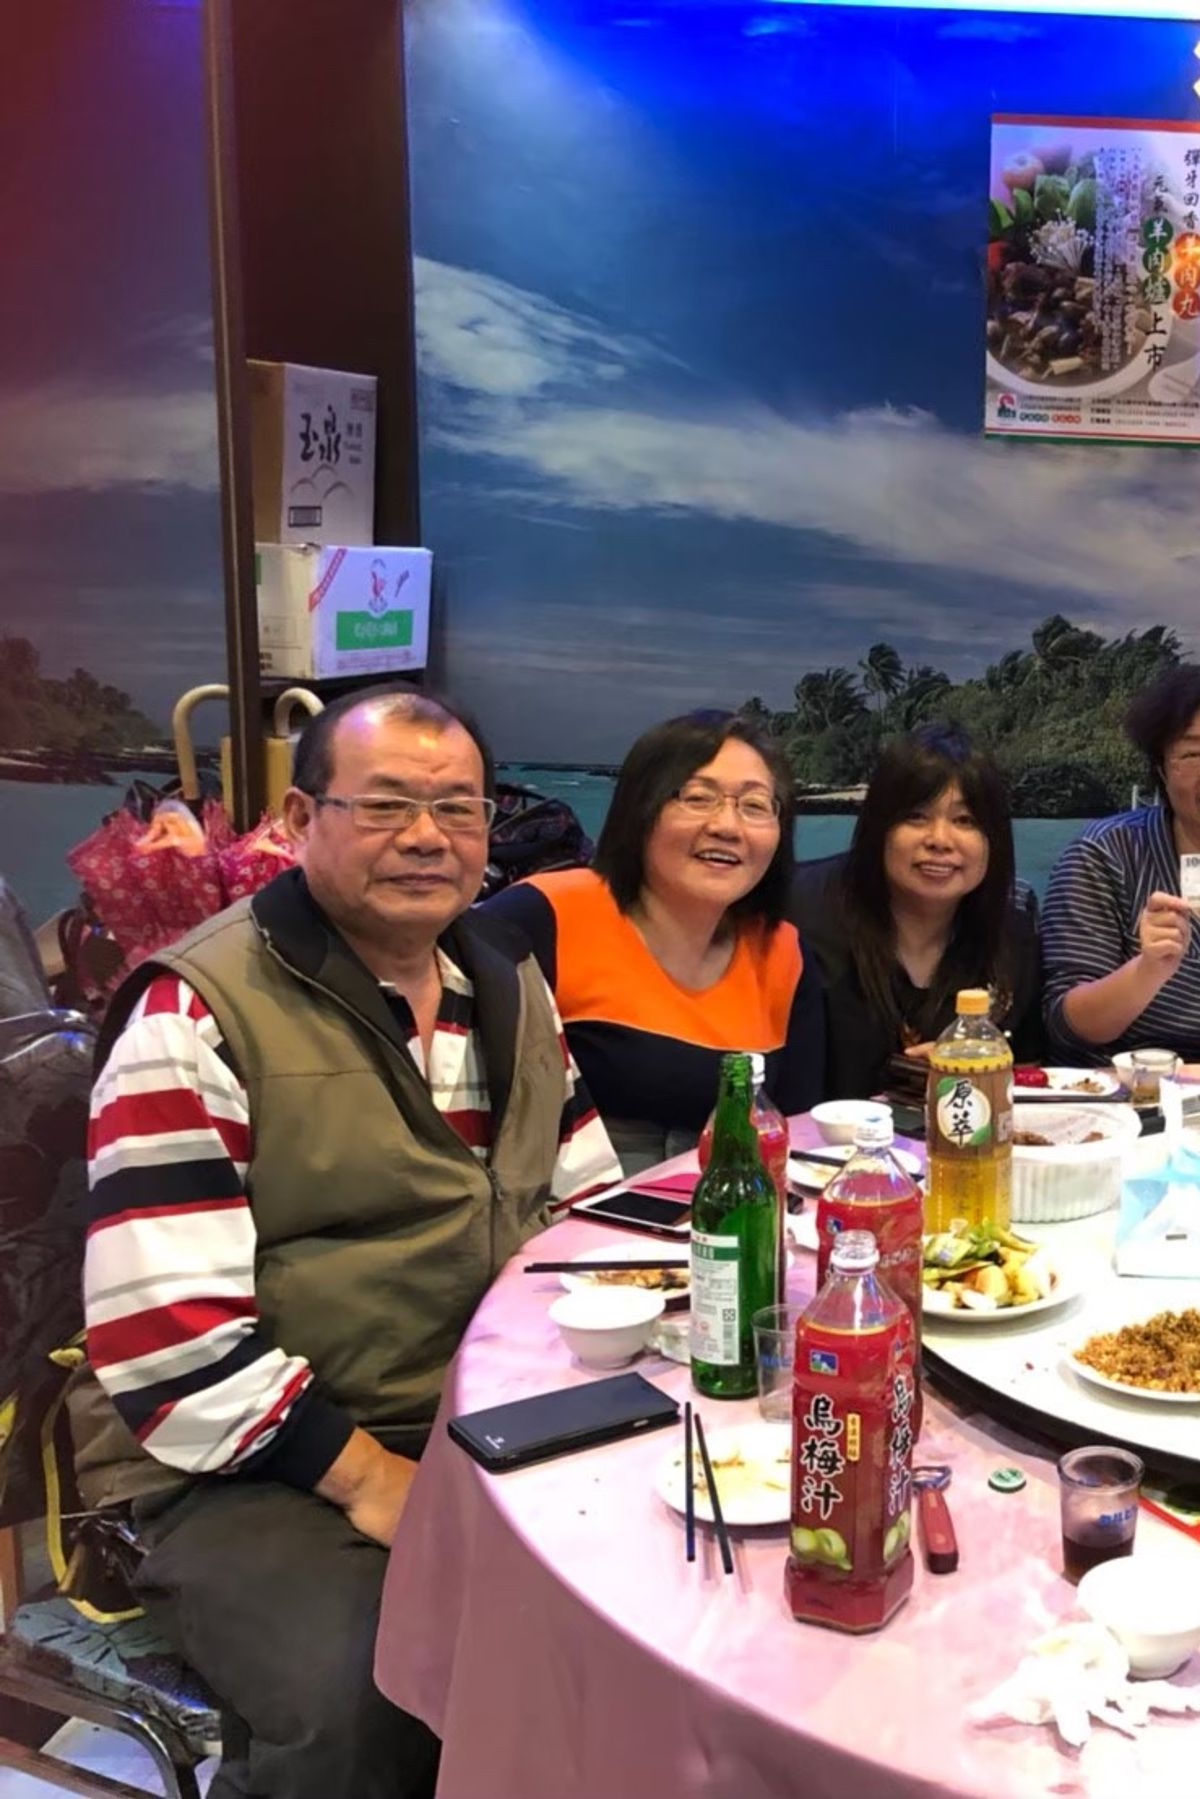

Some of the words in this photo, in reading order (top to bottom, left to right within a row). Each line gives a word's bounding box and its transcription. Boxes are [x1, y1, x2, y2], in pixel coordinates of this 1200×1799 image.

[299, 403, 341, 464] 玉泉
[946, 1077, 975, 1149] 原萃
[801, 1393, 844, 1521] 烏梅汁
